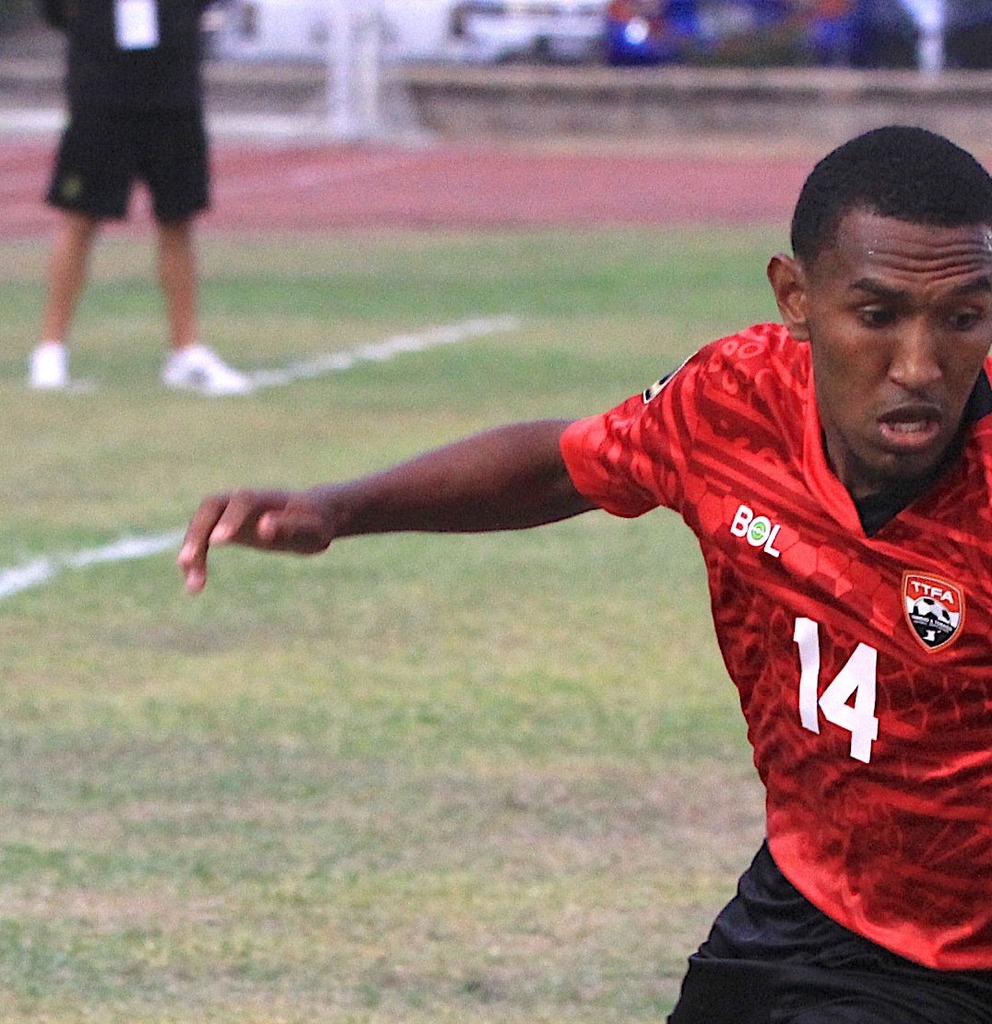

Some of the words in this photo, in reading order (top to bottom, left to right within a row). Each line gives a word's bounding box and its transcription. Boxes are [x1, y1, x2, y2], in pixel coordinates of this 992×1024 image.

[730, 504, 781, 558] BOL
[910, 580, 954, 604] TTFA
[793, 617, 879, 764] 14
